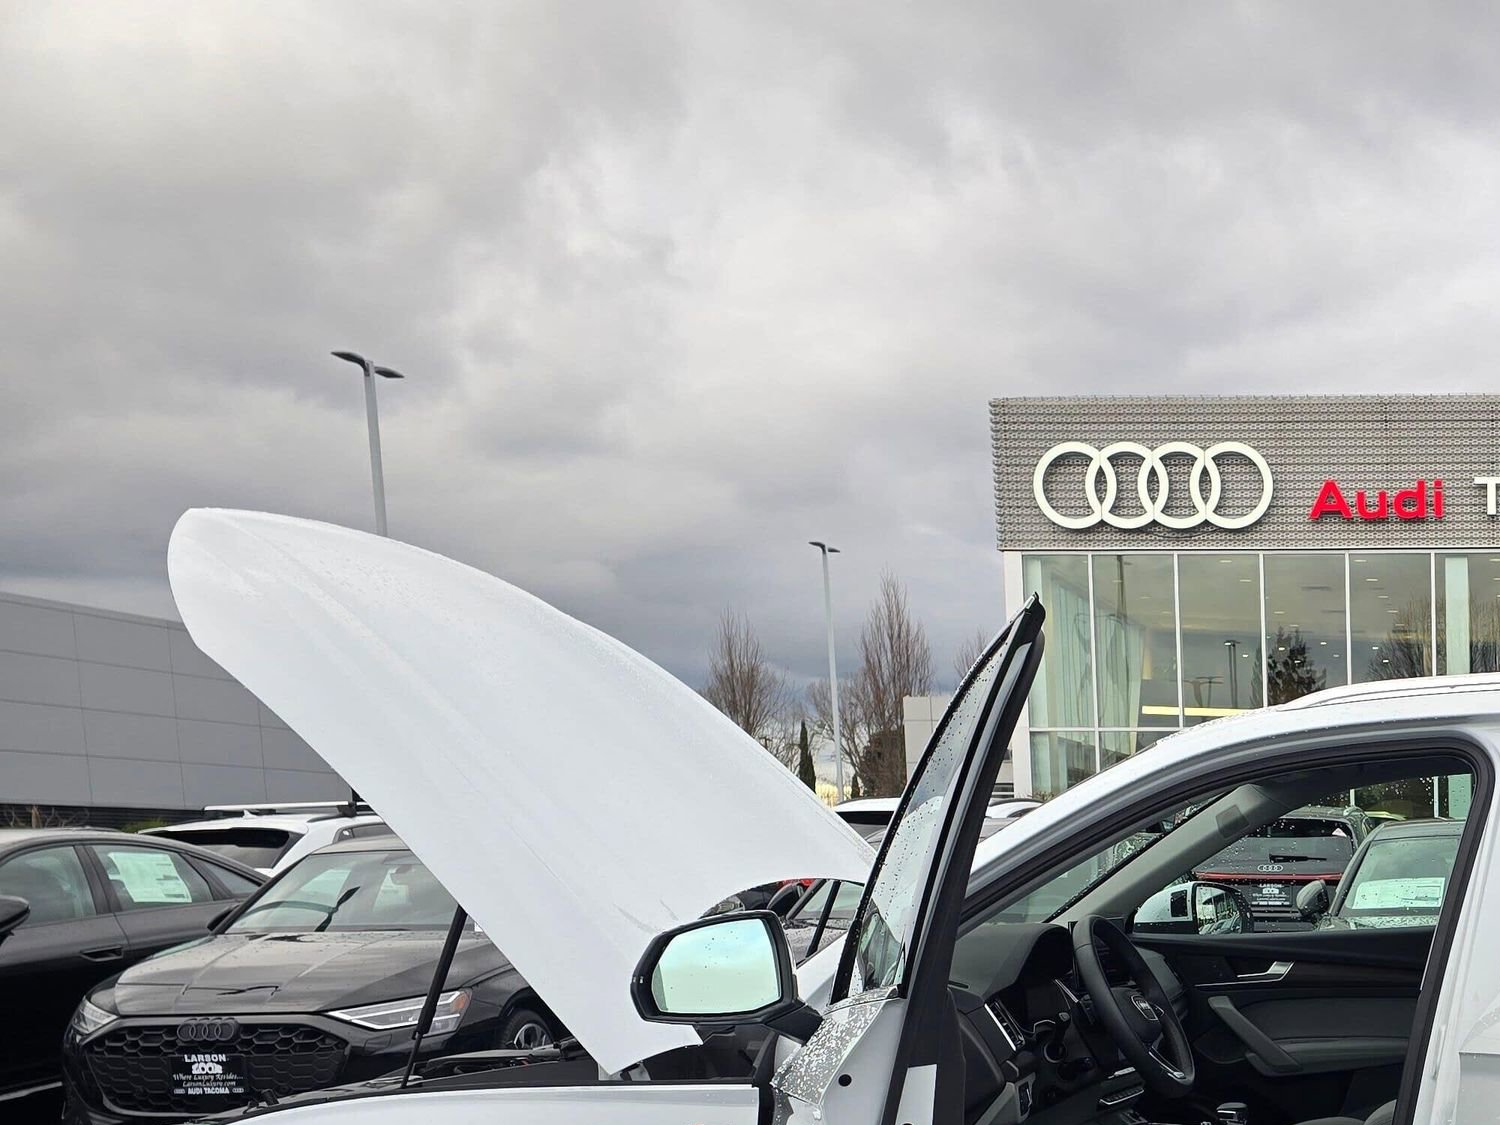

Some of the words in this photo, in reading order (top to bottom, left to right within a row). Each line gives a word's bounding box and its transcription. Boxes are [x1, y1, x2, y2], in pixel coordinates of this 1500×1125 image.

[1309, 479, 1444, 520] Audi
[184, 1054, 227, 1062] LARSON
[187, 1087, 203, 1095] AUDI
